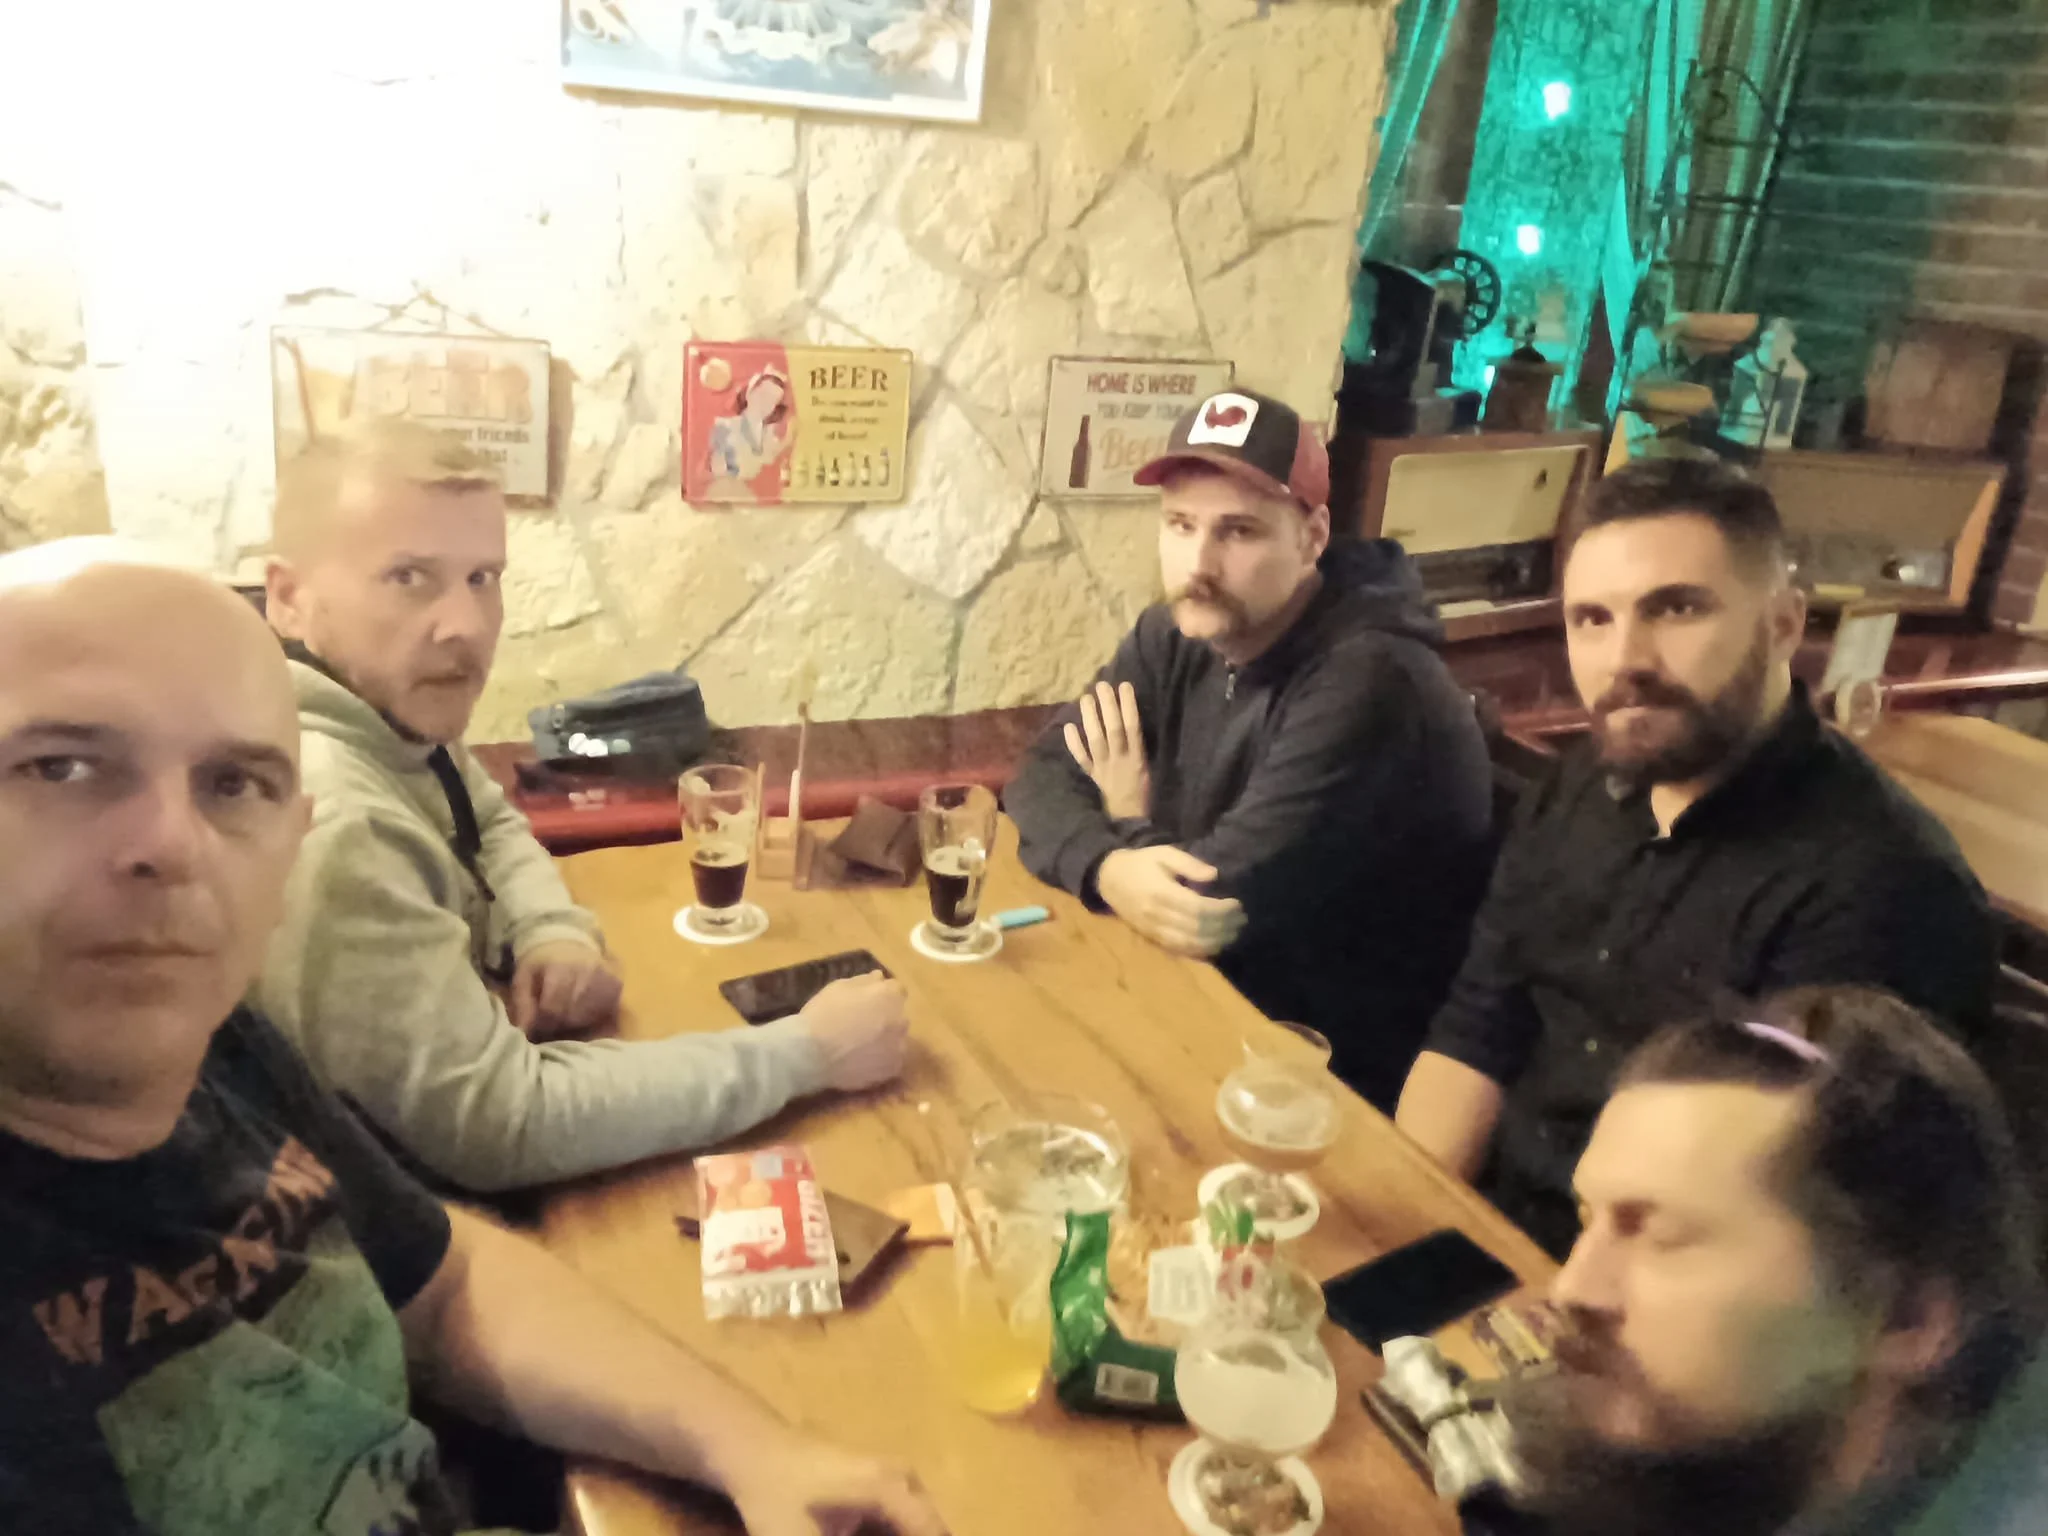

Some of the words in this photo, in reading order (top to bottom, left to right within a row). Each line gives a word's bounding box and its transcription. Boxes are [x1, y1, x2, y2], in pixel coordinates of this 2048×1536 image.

[809, 364, 889, 392] BEER
[1087, 372, 1130, 394] HOME
[1132, 373, 1145, 394] IS
[1149, 374, 1197, 395] WHERE
